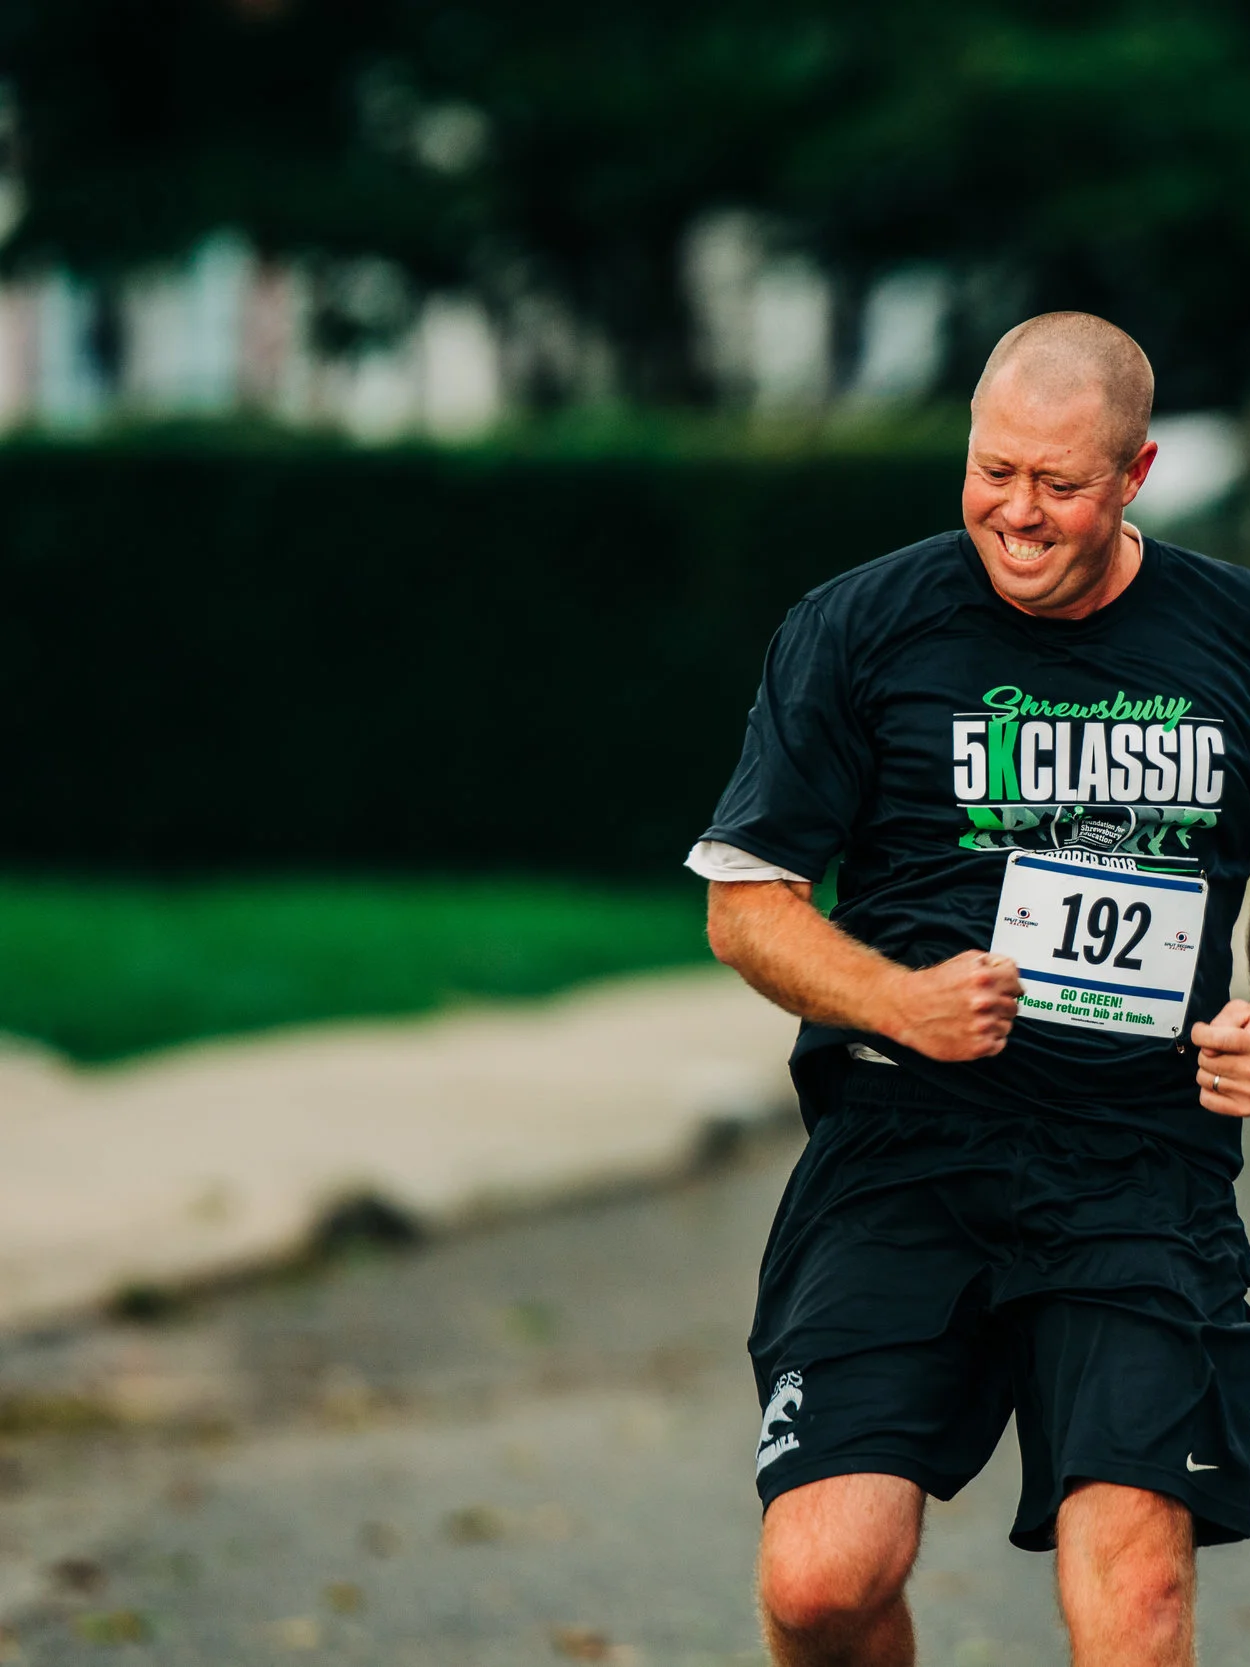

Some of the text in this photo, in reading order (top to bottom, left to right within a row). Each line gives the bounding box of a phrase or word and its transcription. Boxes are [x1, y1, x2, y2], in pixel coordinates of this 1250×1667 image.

[982, 685, 1192, 733] Shrewsbury
[1080, 824, 1123, 841] Shrewsbury
[1101, 856, 1137, 871] 2018
[1052, 892, 1151, 971] 192
[1017, 994, 1054, 1011] Please
[1056, 1002, 1090, 1017] return
[1092, 1007, 1110, 1020] bib
[1112, 1012, 1124, 1022] at
[1125, 1011, 1155, 1026] finish.
[1060, 988, 1123, 1008] GO GREEN!
